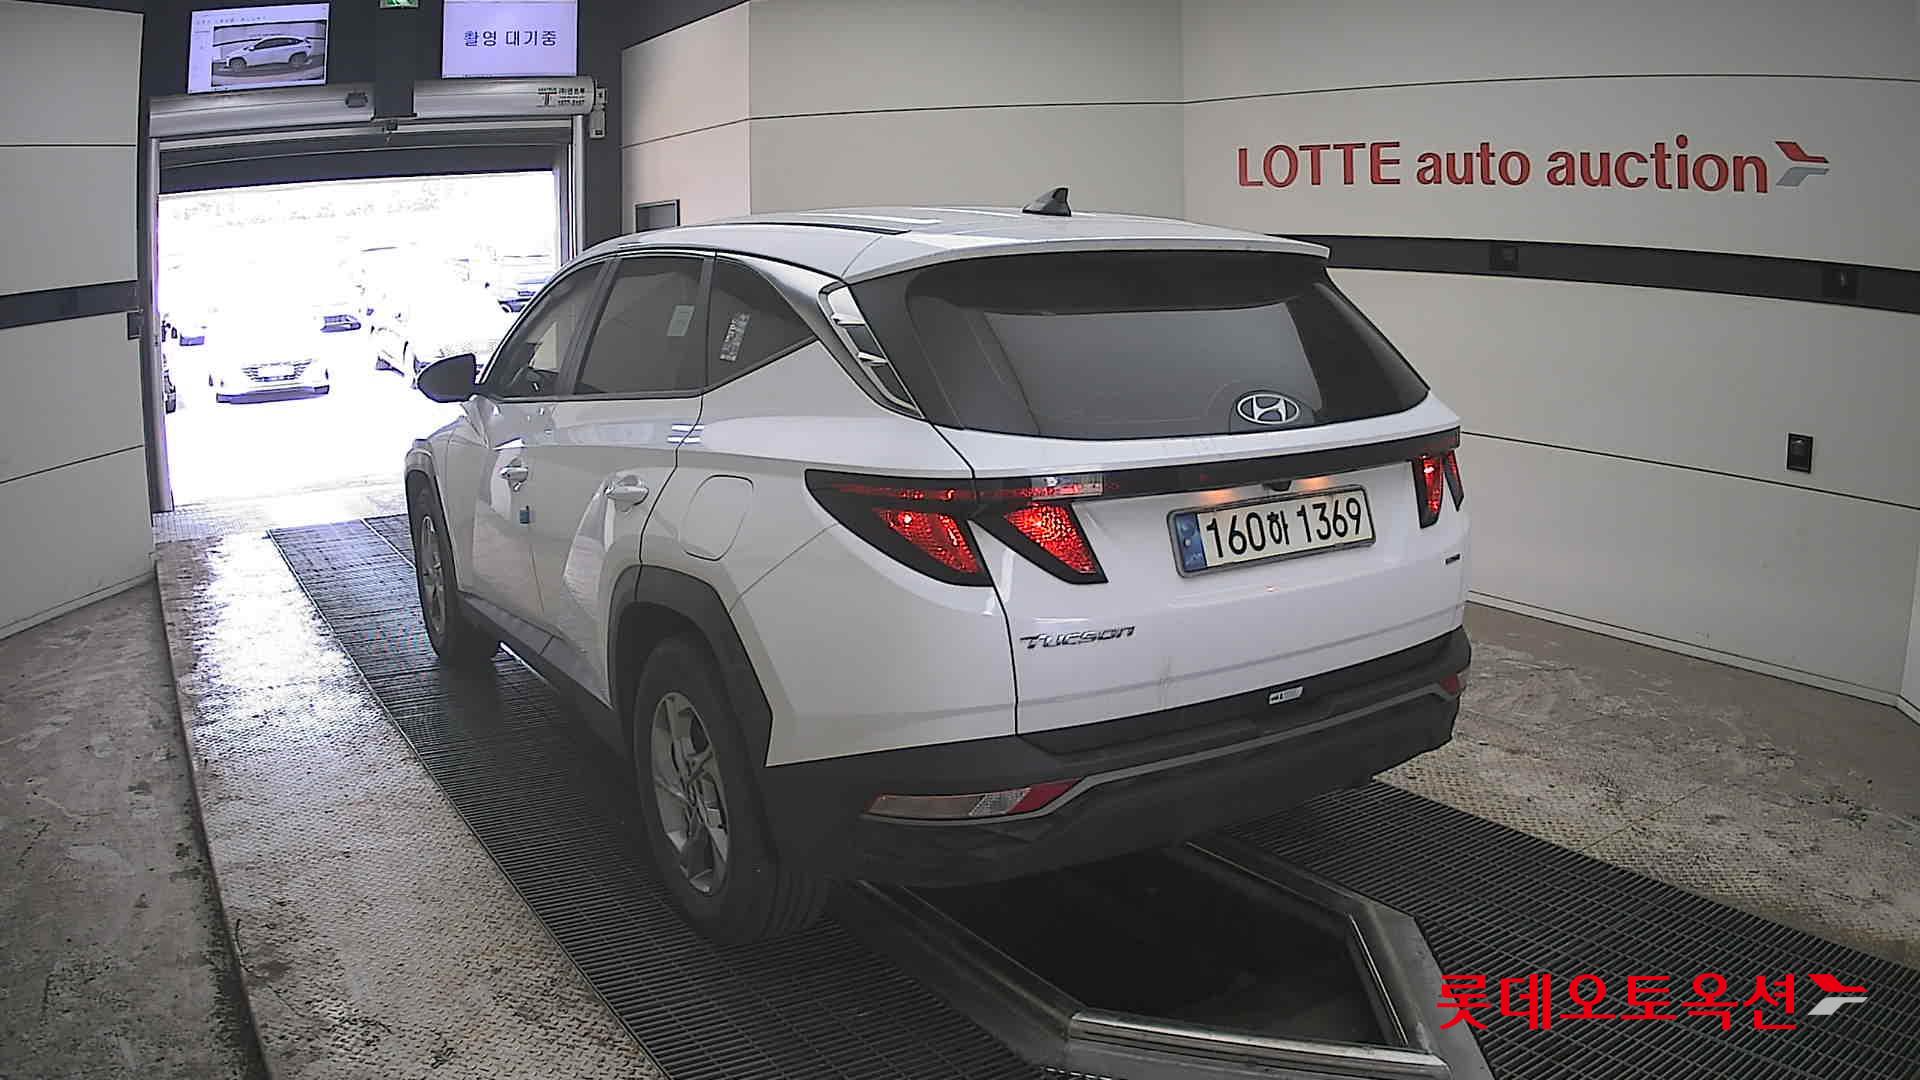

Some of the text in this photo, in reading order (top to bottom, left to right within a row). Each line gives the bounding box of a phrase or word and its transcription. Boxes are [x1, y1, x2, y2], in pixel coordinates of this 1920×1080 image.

[505, 30, 557, 46] 대기중
[1238, 134, 1768, 194] LOTTE auto auction
[1206, 497, 1362, 558] 160하 1369
[1019, 625, 1136, 649] TUCSON
